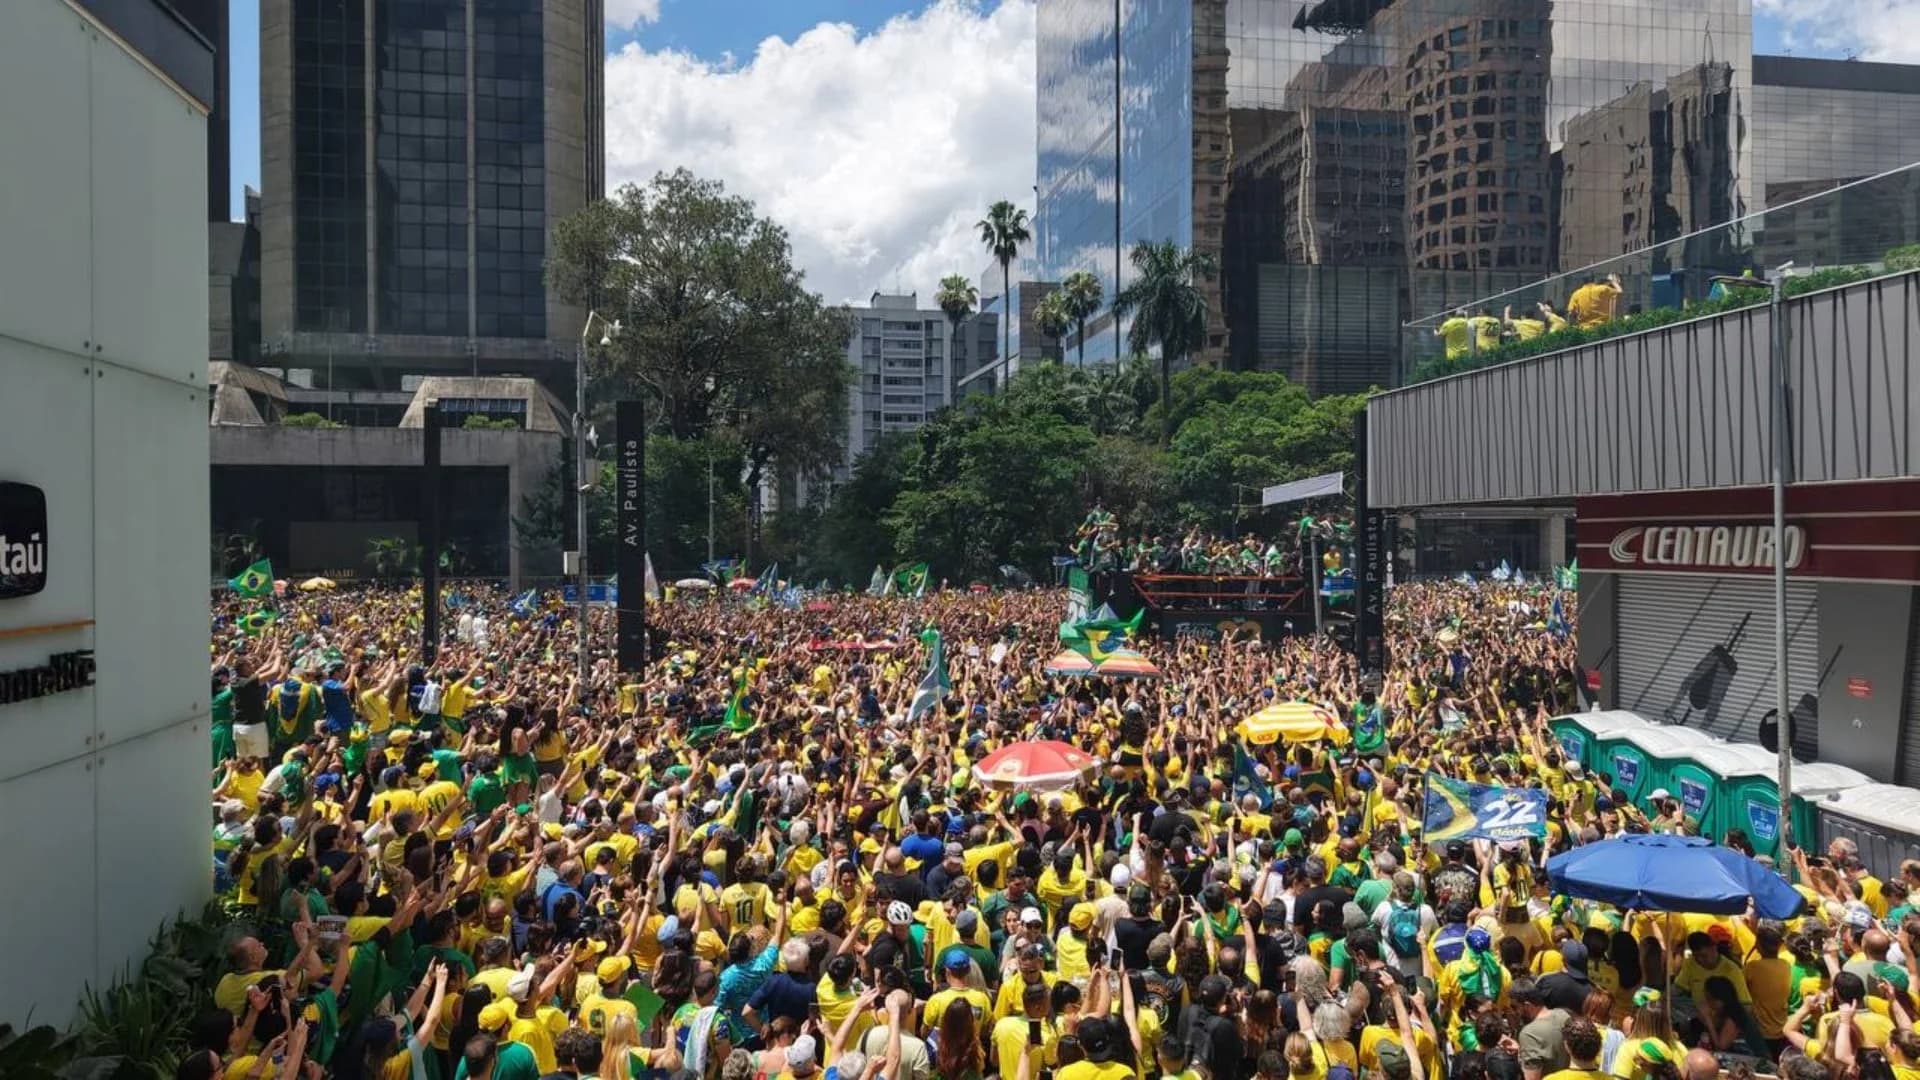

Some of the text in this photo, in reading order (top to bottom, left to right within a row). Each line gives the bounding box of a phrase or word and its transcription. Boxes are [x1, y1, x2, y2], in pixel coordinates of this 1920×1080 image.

[624, 440, 637, 546] Av. Paulista
[1366, 516, 1378, 582] Paulista
[1481, 799, 1537, 829] 22
[736, 899, 754, 924] 10
